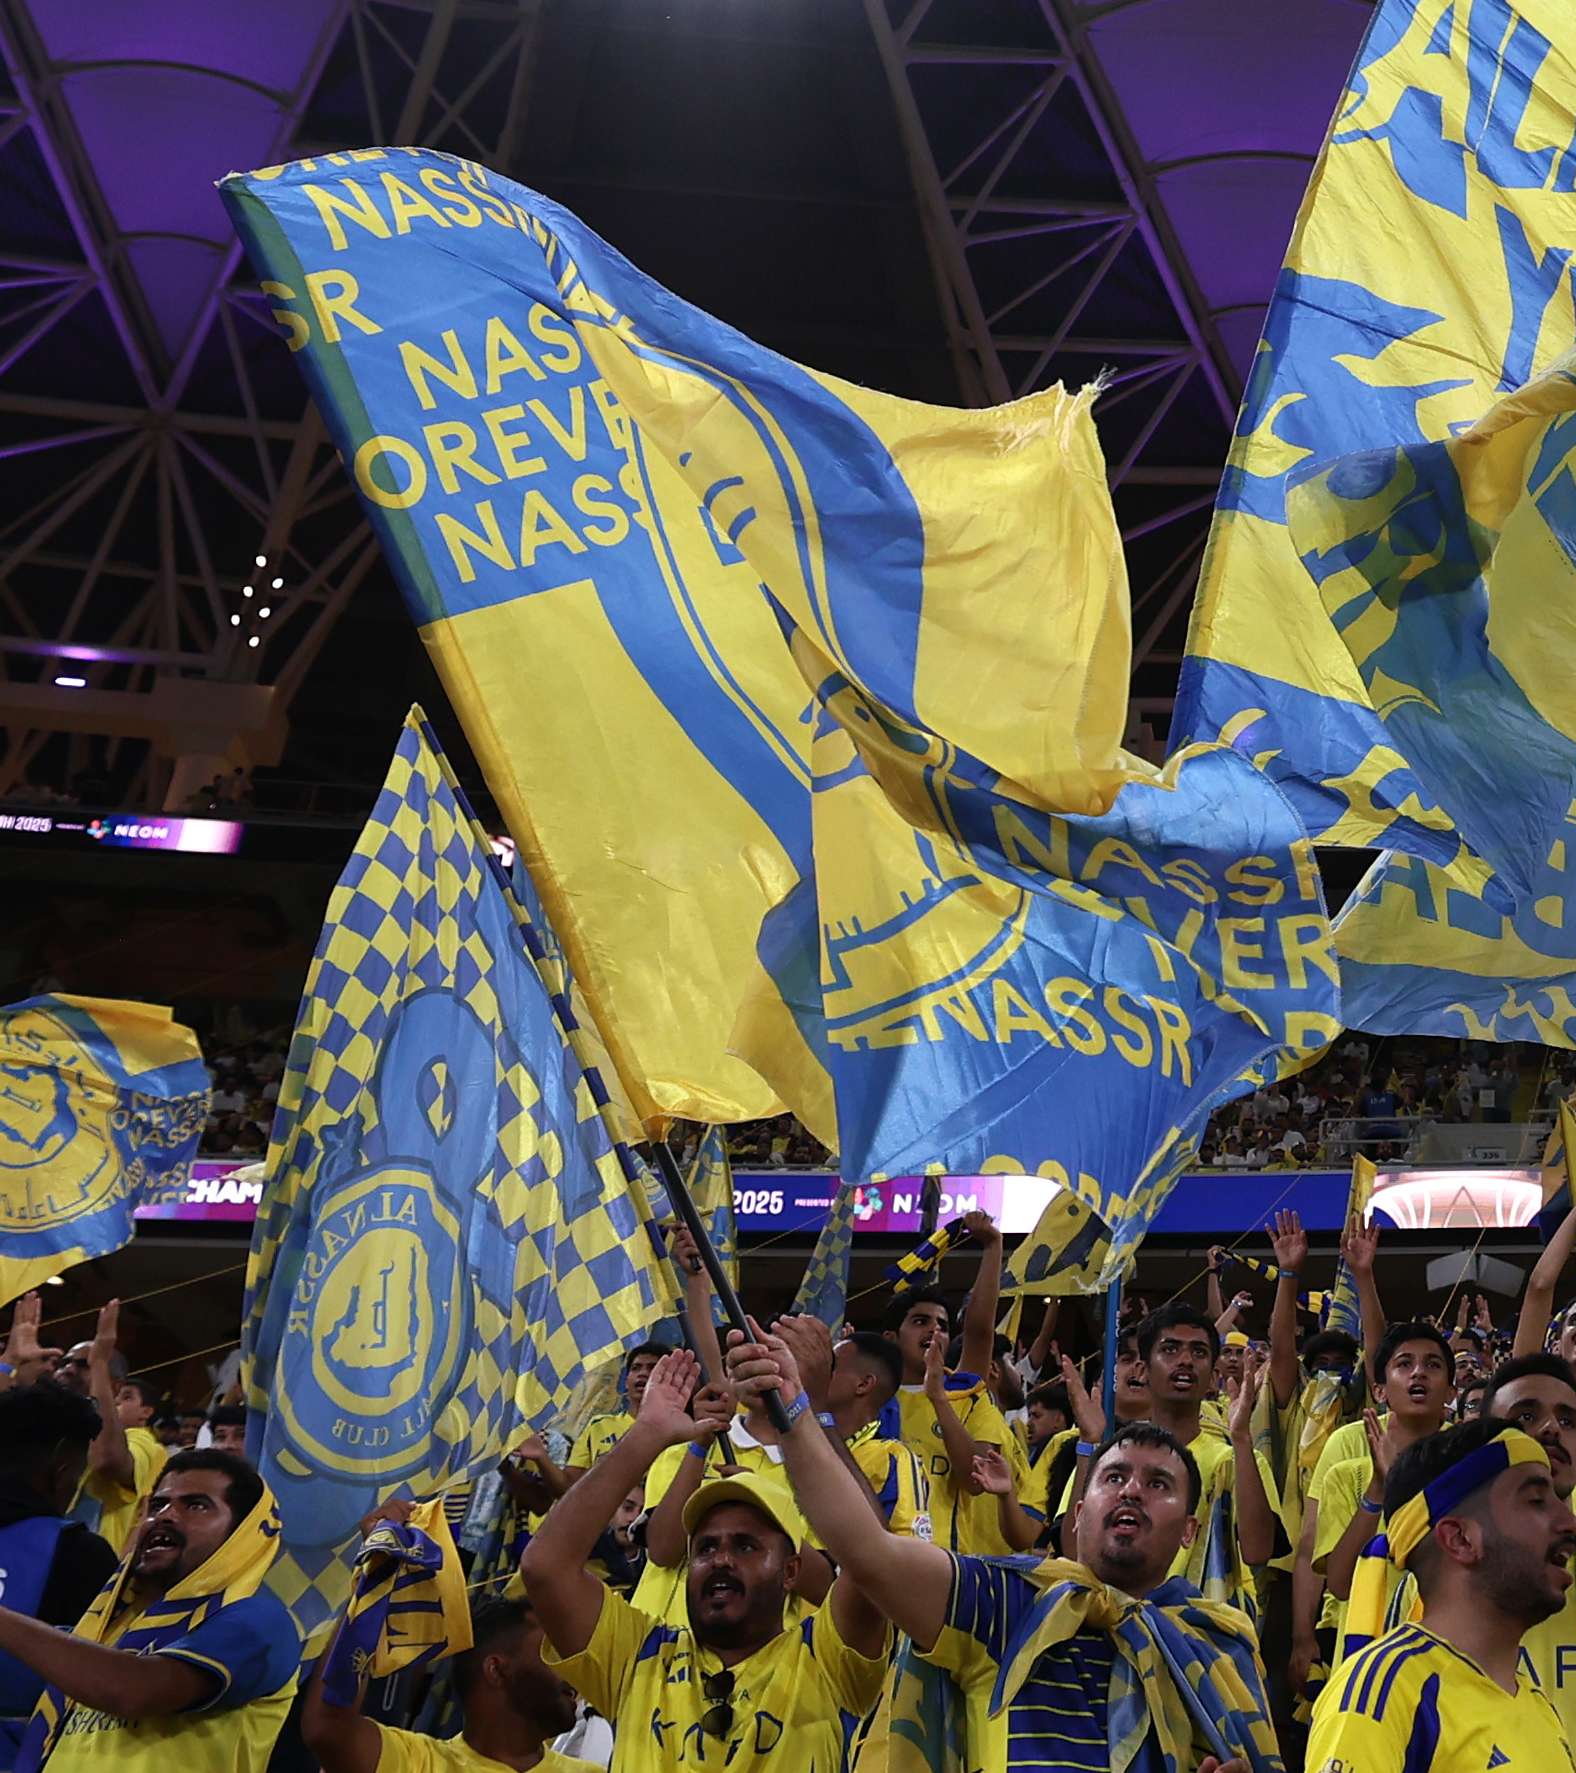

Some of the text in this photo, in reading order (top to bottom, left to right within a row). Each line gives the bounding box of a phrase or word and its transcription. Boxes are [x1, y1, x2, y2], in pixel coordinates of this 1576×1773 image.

[14, 815, 51, 832] 2025
[114, 824, 169, 840] NEOM
[732, 1190, 784, 1215] 2025
